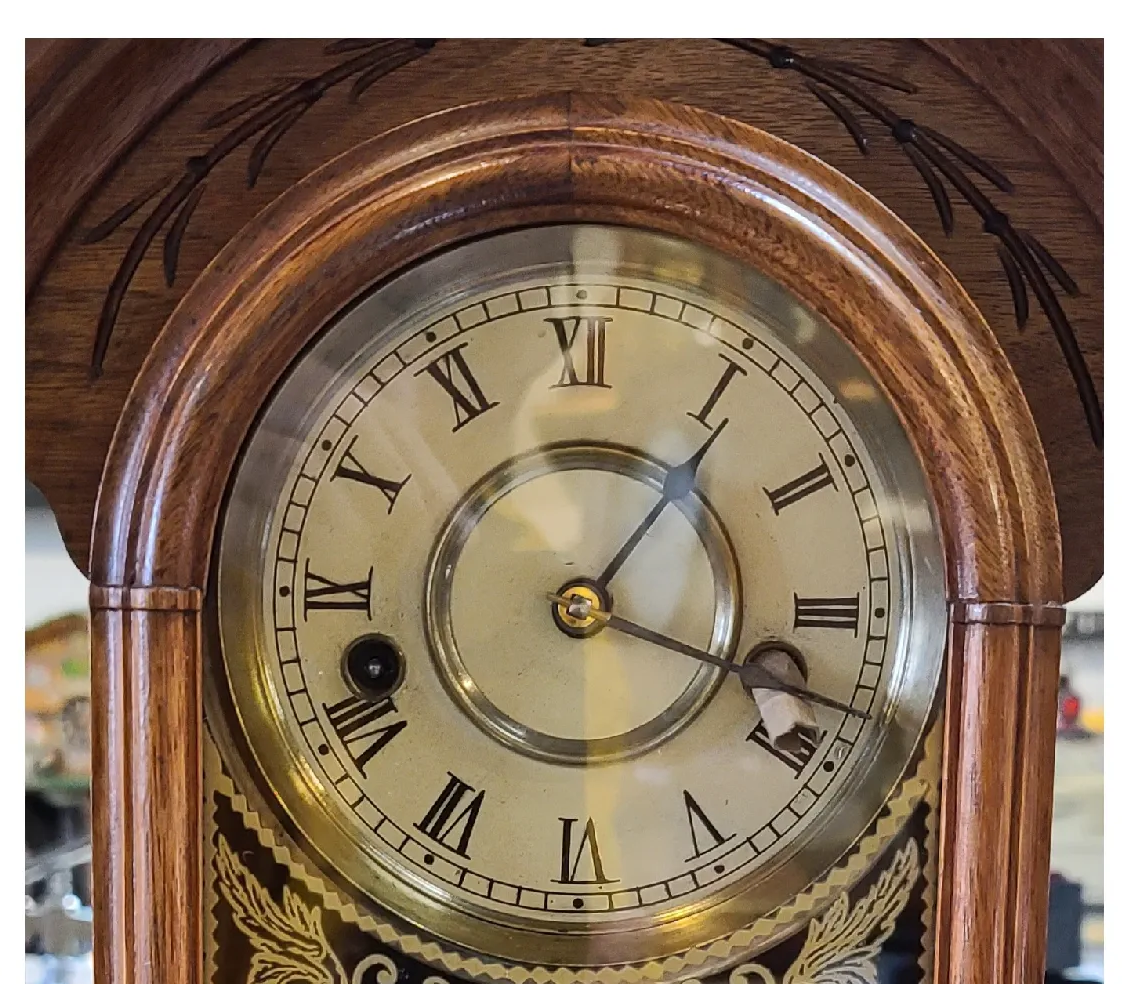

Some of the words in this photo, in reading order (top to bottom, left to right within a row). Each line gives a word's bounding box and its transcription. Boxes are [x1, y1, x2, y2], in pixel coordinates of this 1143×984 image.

[413, 342, 500, 433] XI
[543, 315, 614, 389] XII
[686, 353, 747, 430] I
[330, 434, 412, 515] X
[762, 452, 838, 516] II
[304, 558, 373, 622] IX
[793, 591, 860, 639] III
[413, 771, 485, 859] VII
[550, 816, 620, 884] VI
[683, 789, 737, 863] V
